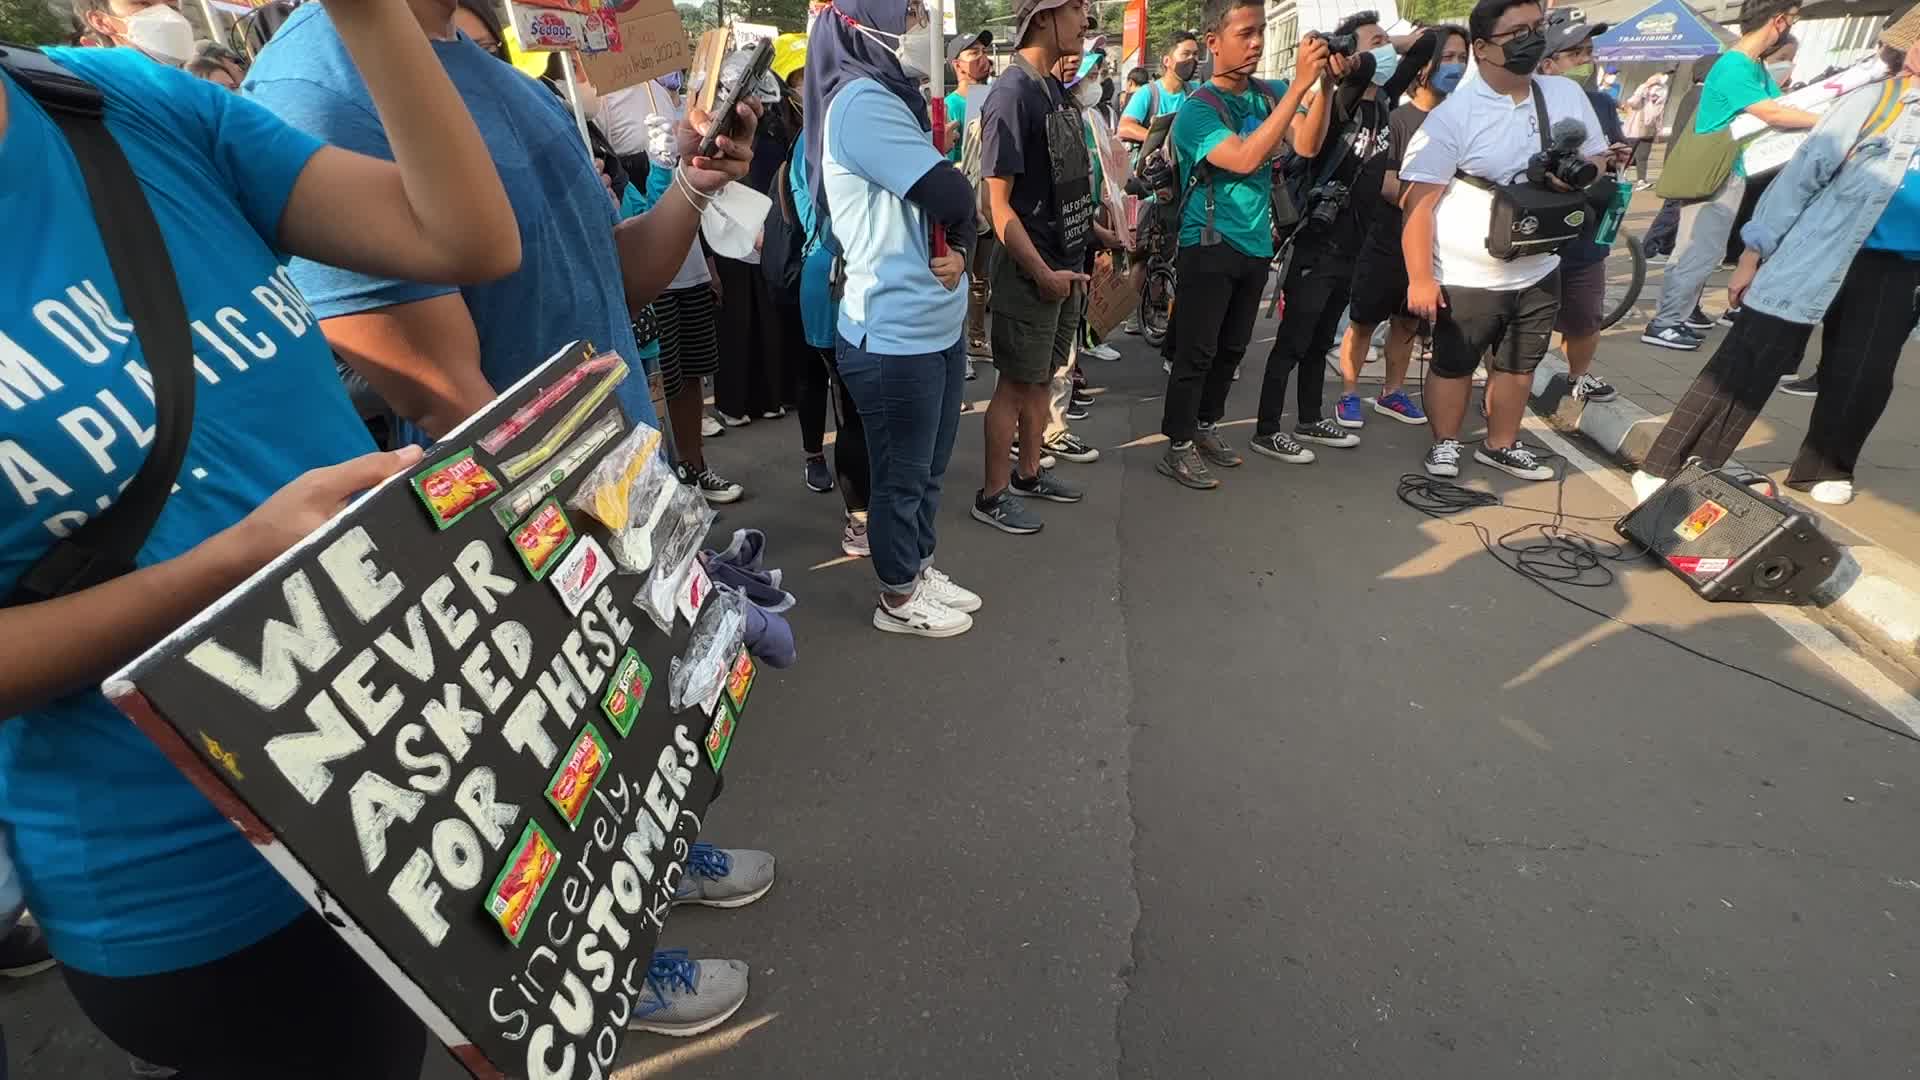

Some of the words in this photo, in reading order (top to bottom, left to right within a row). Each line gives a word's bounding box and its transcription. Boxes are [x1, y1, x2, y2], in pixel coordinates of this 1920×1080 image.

[0, 439, 74, 506] A
[57, 306, 278, 475] PLAIC
[32, 279, 134, 364] ON
[185, 526, 404, 710] WE
[264, 540, 517, 804] NEVER
[350, 620, 534, 873] ASKED
[389, 765, 521, 949] FOR
[501, 592, 635, 769] THESE
[526, 724, 700, 1080] CUSTOMERS
